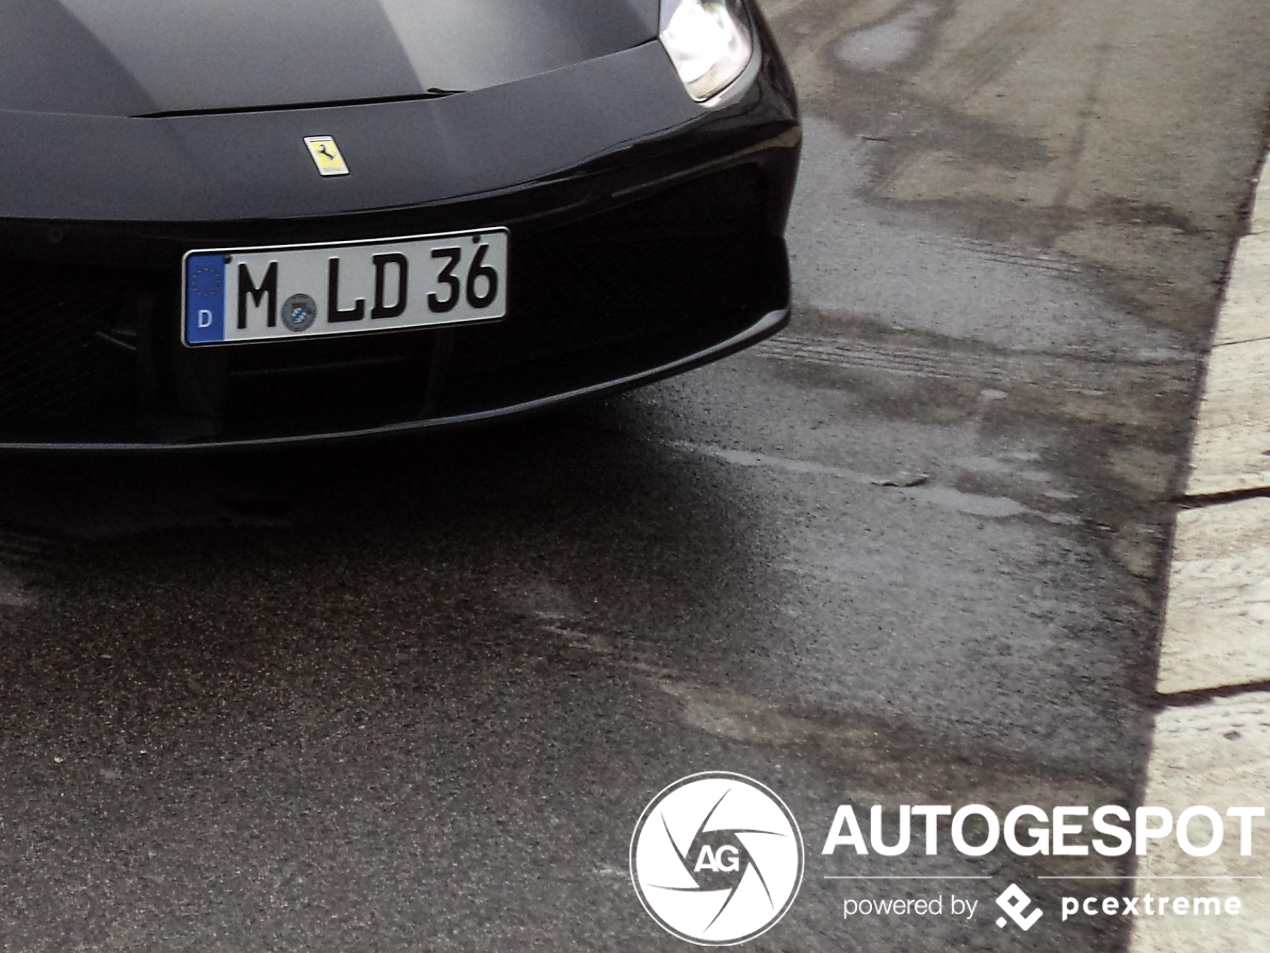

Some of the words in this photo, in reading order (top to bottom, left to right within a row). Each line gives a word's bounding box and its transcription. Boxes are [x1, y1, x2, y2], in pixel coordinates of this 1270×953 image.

[236, 260, 278, 330] M
[326, 252, 409, 324] LD
[426, 244, 498, 314] 36
[197, 309, 213, 328] D
